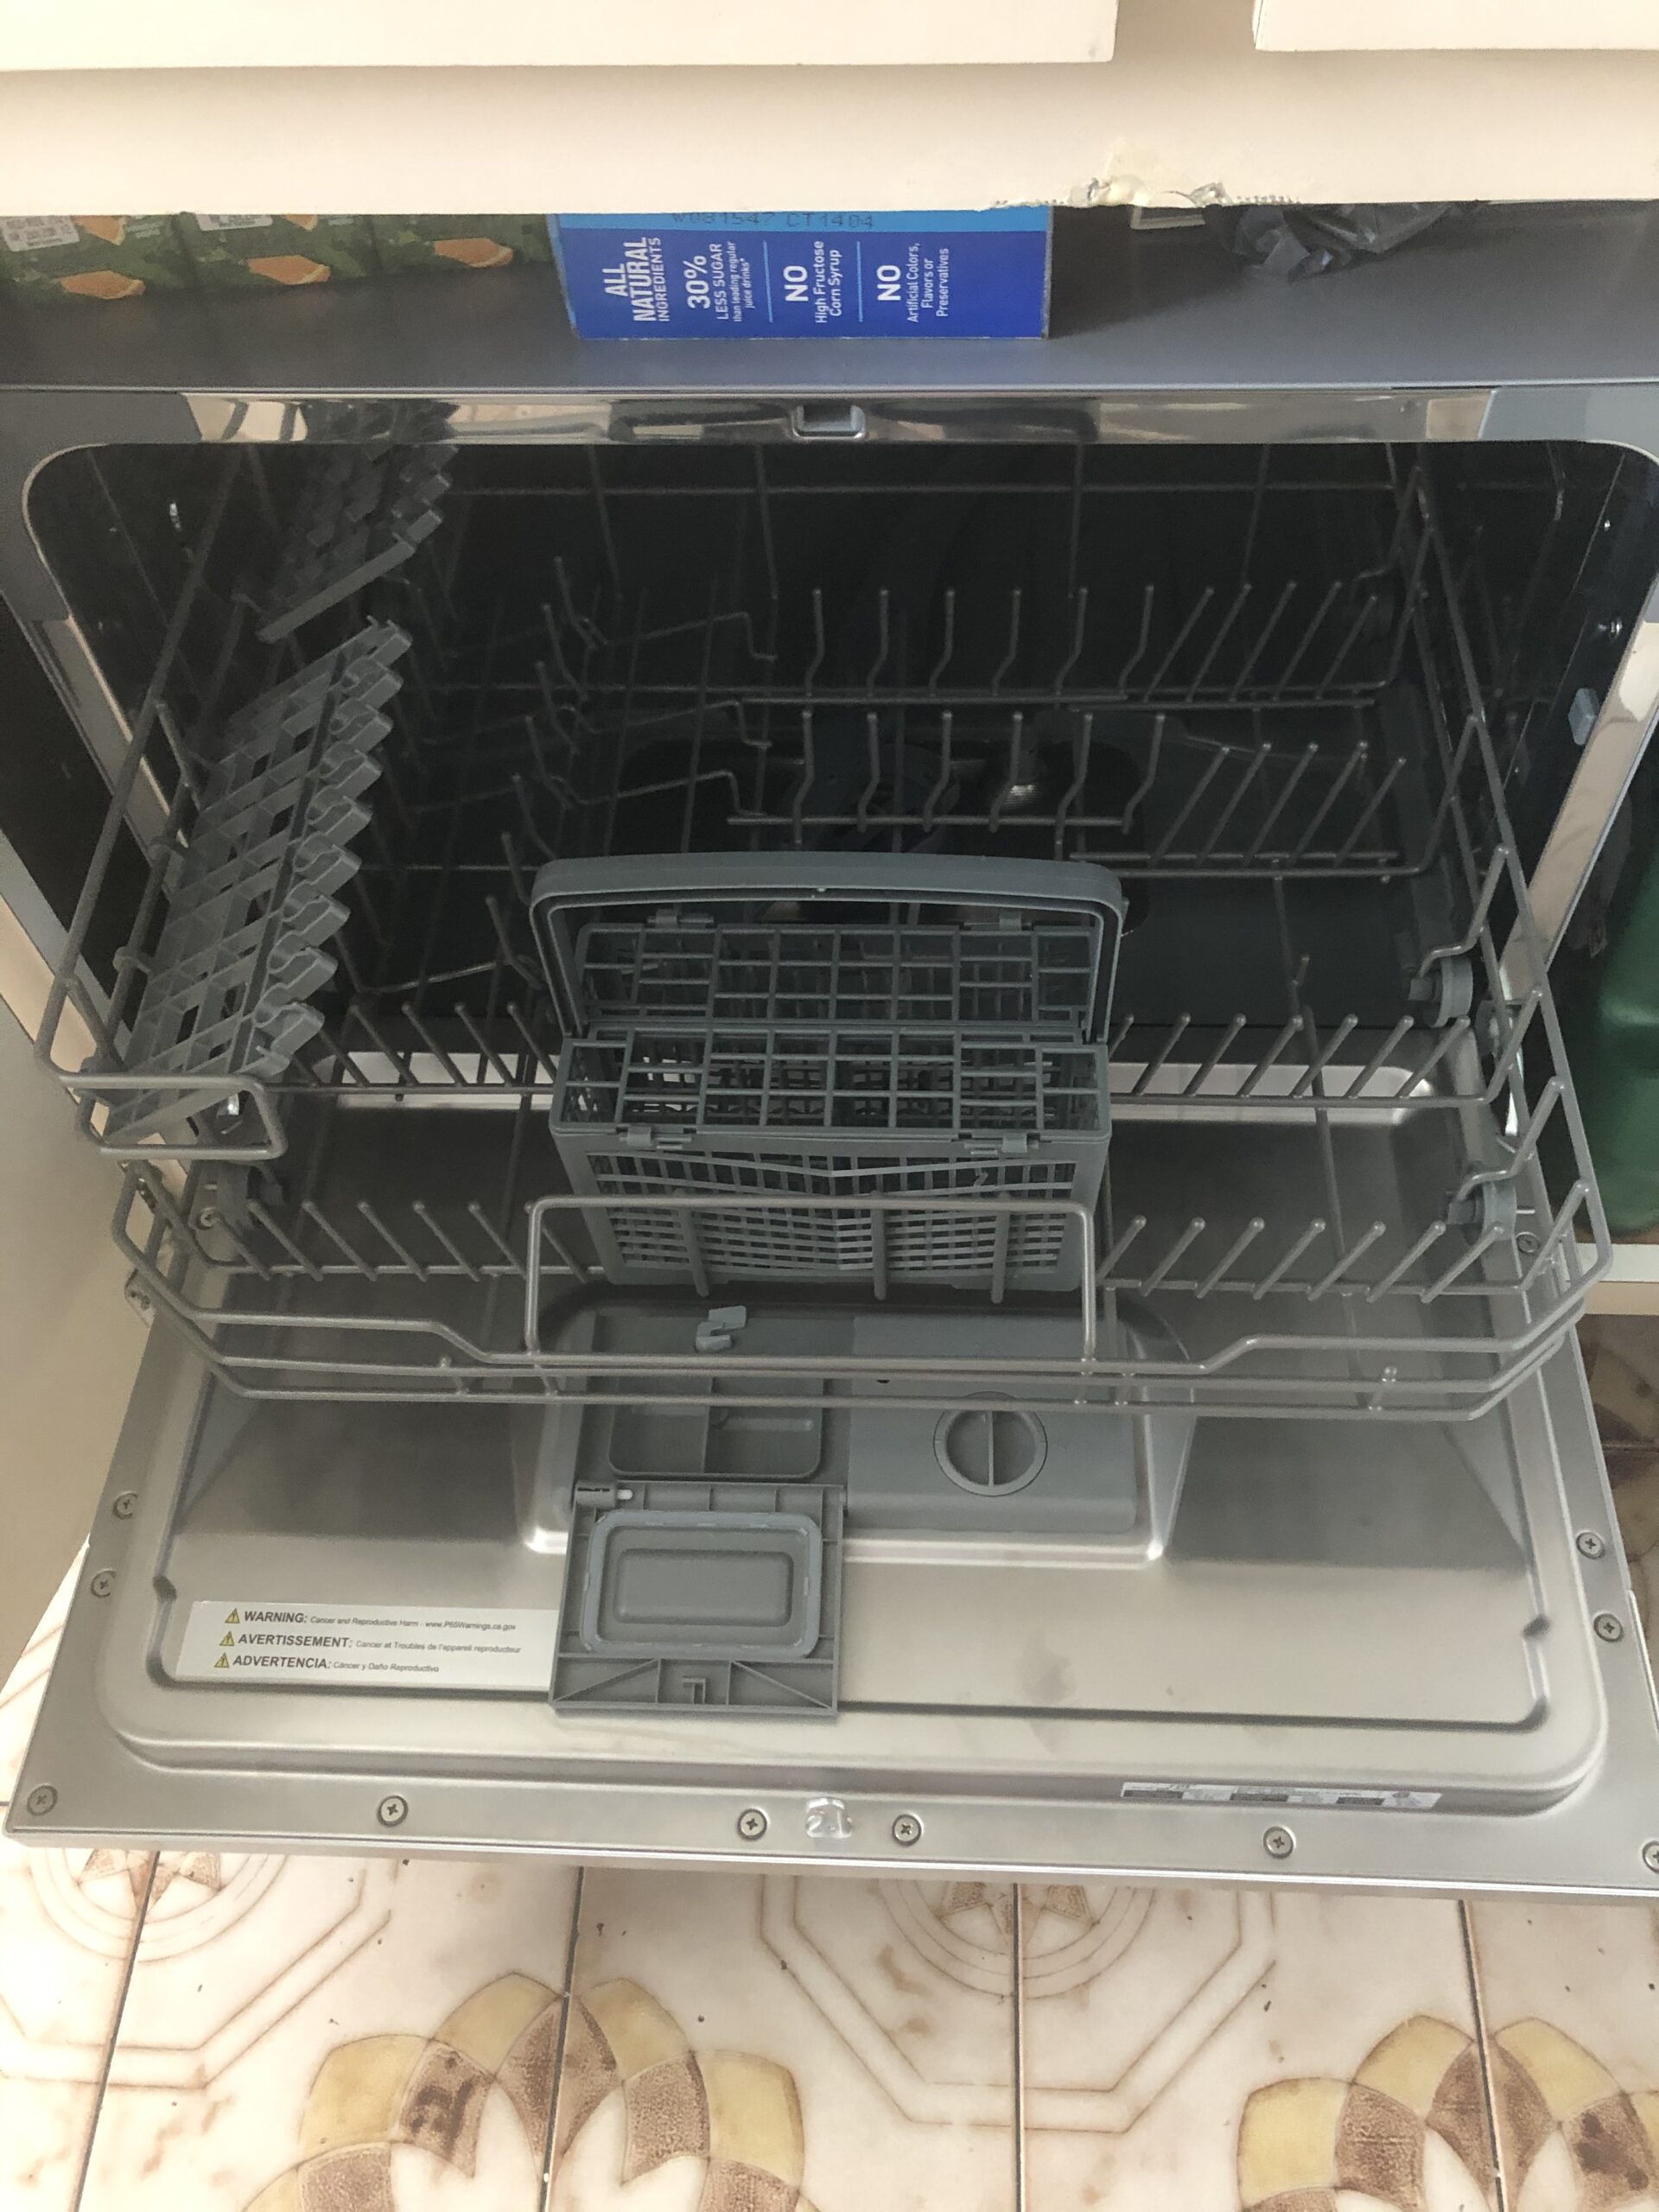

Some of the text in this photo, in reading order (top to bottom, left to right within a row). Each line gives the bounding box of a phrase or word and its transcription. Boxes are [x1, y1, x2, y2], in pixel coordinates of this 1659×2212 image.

[602, 264, 629, 297] ALL
[623, 237, 657, 321] NATURAL
[649, 238, 671, 321] INGREDIENTS
[683, 255, 711, 309] 30%
[709, 244, 728, 320] LESS SUGAR
[728, 241, 742, 321] than leading regular
[742, 290, 755, 308] juice
[784, 265, 809, 302] NO
[814, 241, 829, 323] High Fructose
[829, 249, 842, 316] Corn Syrup
[876, 264, 901, 302] NO
[906, 243, 920, 322] Artificial Colors,
[921, 258, 933, 308] Flavors or
[936, 249, 949, 317] Preservatives
[238, 1634, 353, 1649] AVERTISSEMENT:
[356, 1640, 381, 1649] Cancer
[384, 1641, 391, 1649] et
[393, 1641, 425, 1650] Troubles
[428, 1643, 436, 1651] de
[474, 1645, 521, 1654] reproducteur
[245, 1611, 307, 1624] WARNING:
[310, 1616, 334, 1624] Cancer
[353, 1618, 397, 1627] Reproductive
[233, 1656, 331, 1669] ADVERTENCIA:
[334, 1661, 359, 1670] Cáncer
[368, 1662, 388, 1671] Daño
[391, 1663, 439, 1673] Reproductivo
